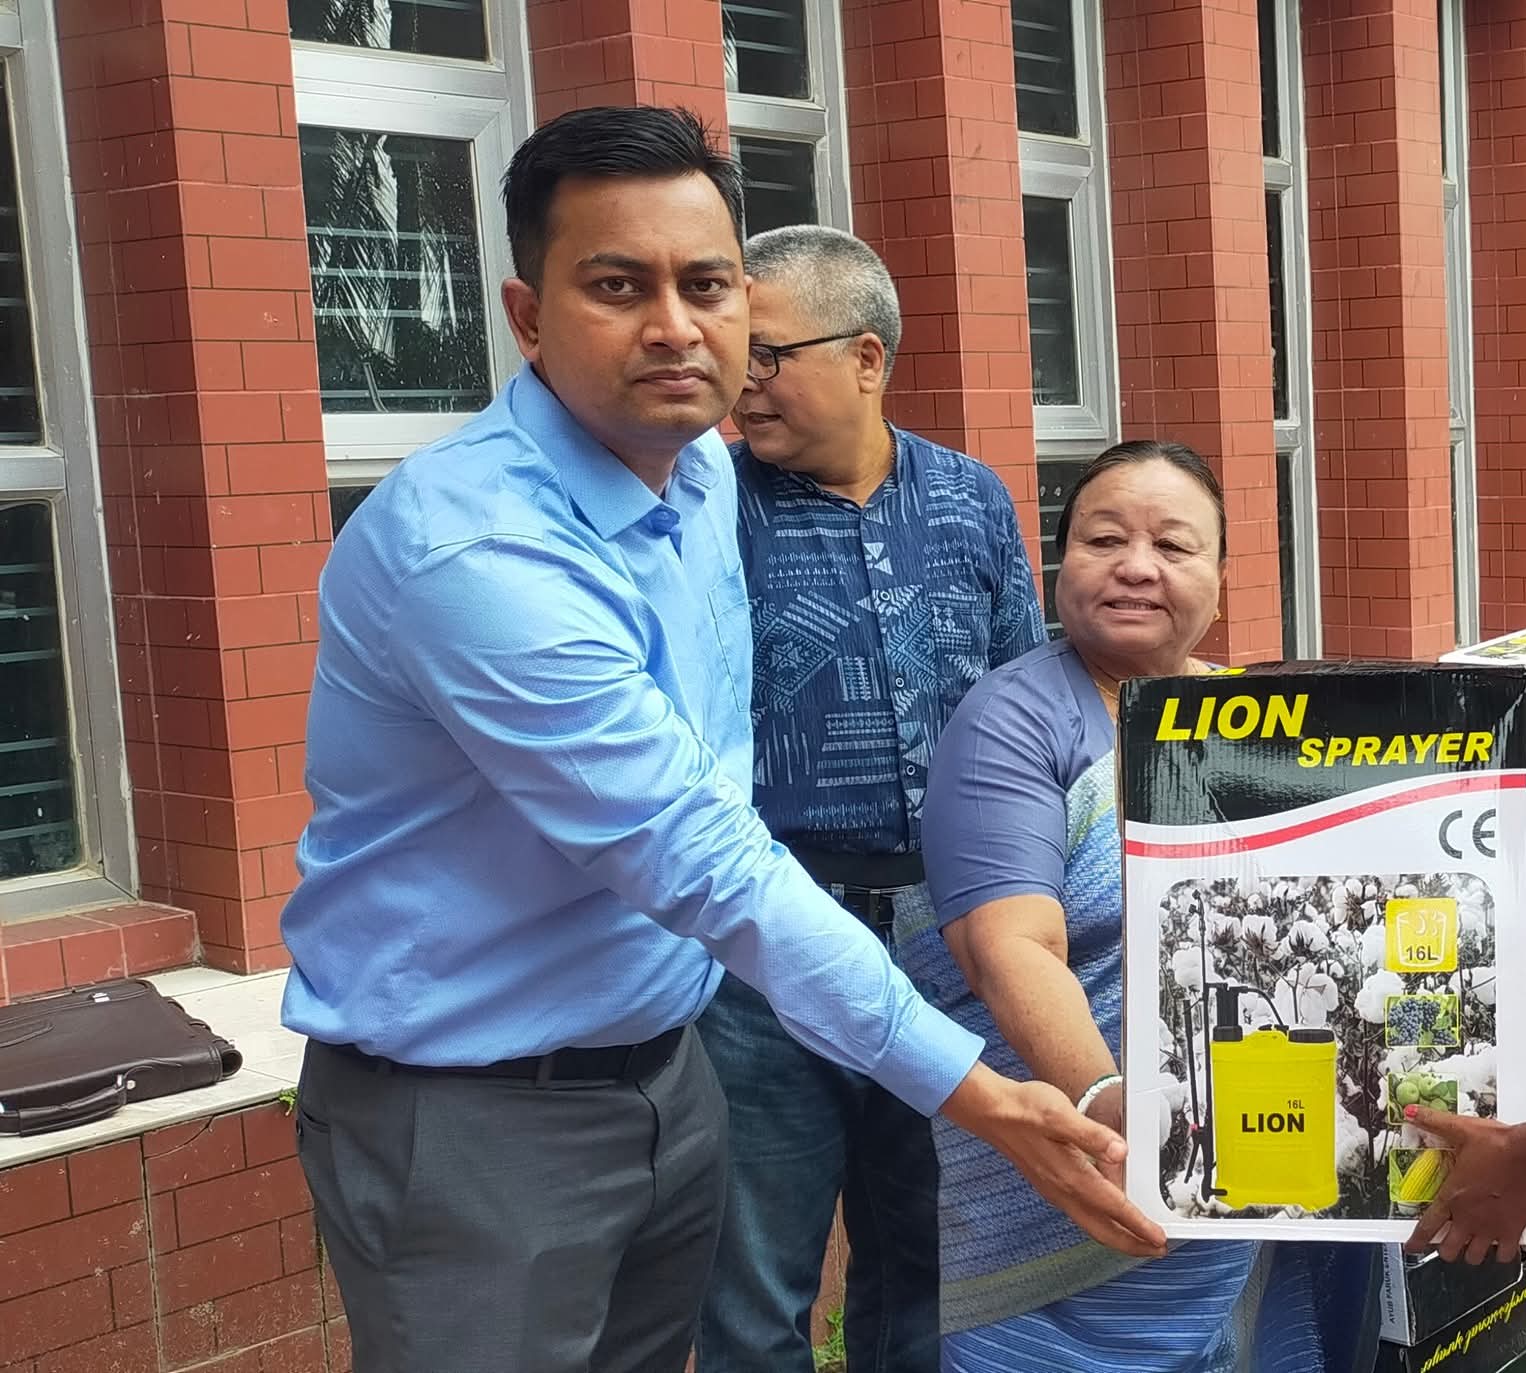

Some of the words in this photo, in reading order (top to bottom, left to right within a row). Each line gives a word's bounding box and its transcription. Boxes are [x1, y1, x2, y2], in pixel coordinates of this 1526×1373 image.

[1155, 693, 1309, 742] LION
[1297, 730, 1494, 768] SPRAYER
[1439, 807, 1497, 859] CE
[1406, 945, 1438, 962] 16L
[1241, 1113, 1305, 1133] LION
[1287, 1100, 1305, 1110] 16L
[1419, 1331, 1464, 1373] sprayer
